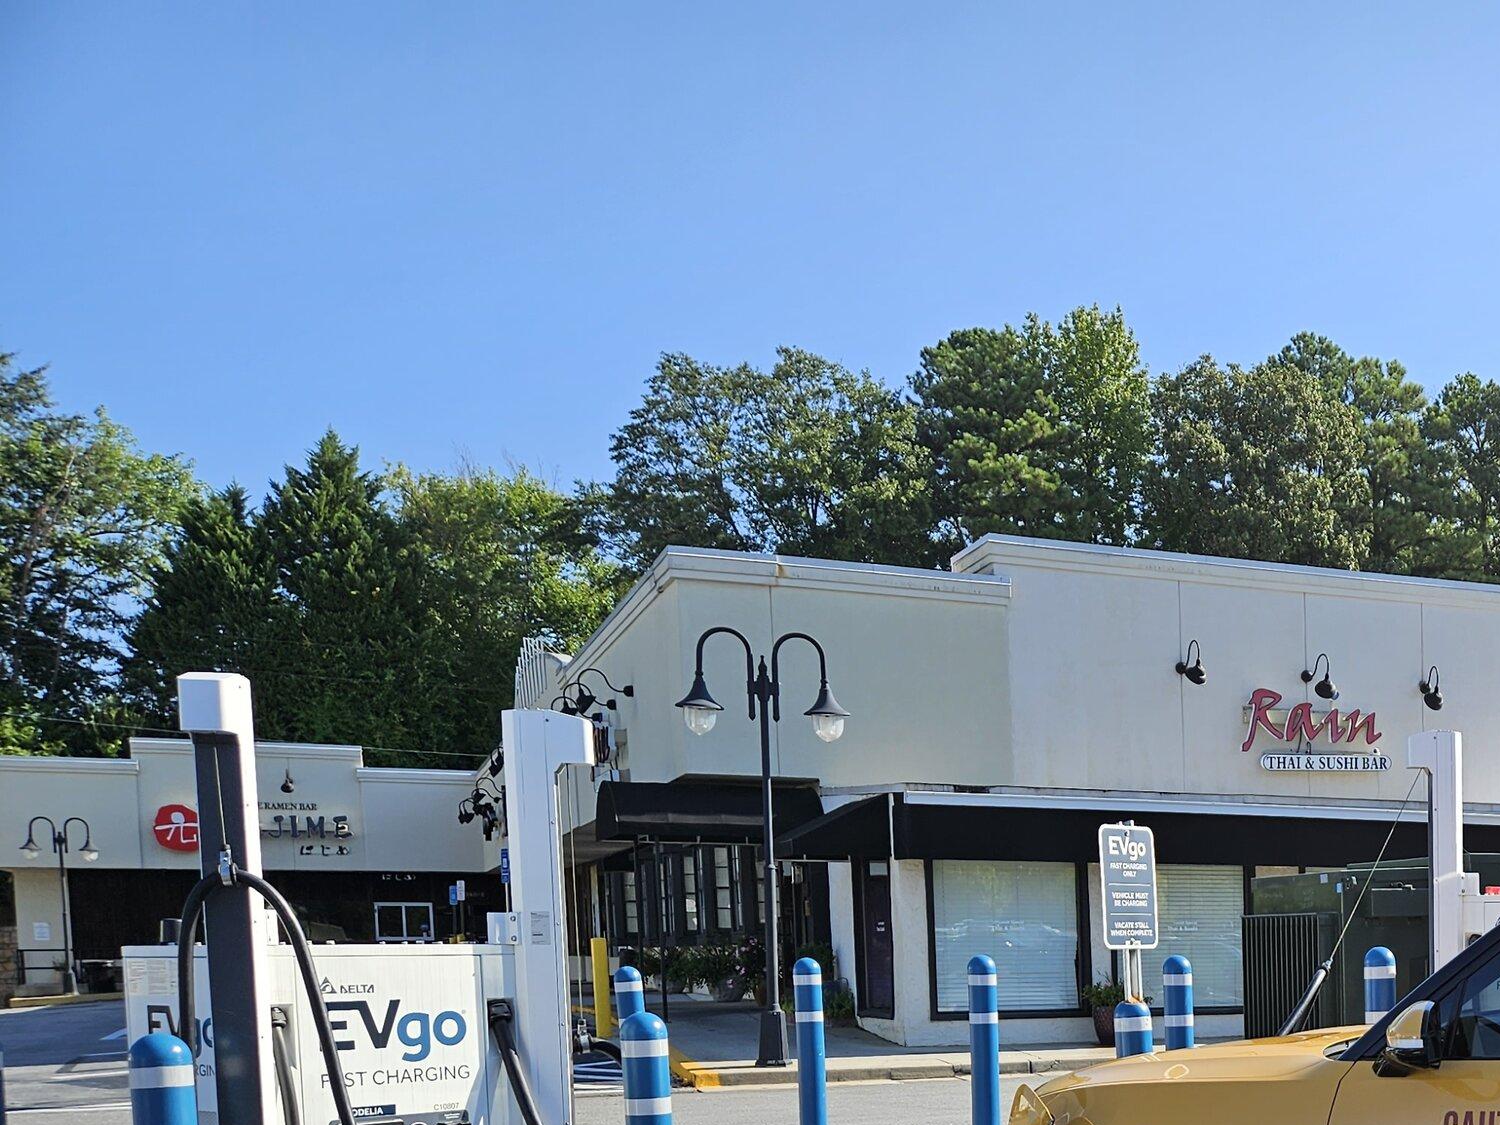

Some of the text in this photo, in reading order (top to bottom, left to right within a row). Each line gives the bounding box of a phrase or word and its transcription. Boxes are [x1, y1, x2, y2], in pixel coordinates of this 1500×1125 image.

[1241, 687, 1382, 752] Rain
[1266, 756, 1388, 770] THAI & SUSHI BAR
[264, 802, 297, 811] RAMEN
[299, 802, 318, 811] BAR
[1108, 835, 1146, 860] EVgo
[340, 984, 374, 994] DELTA
[320, 1064, 470, 1088] FST CHARGING
